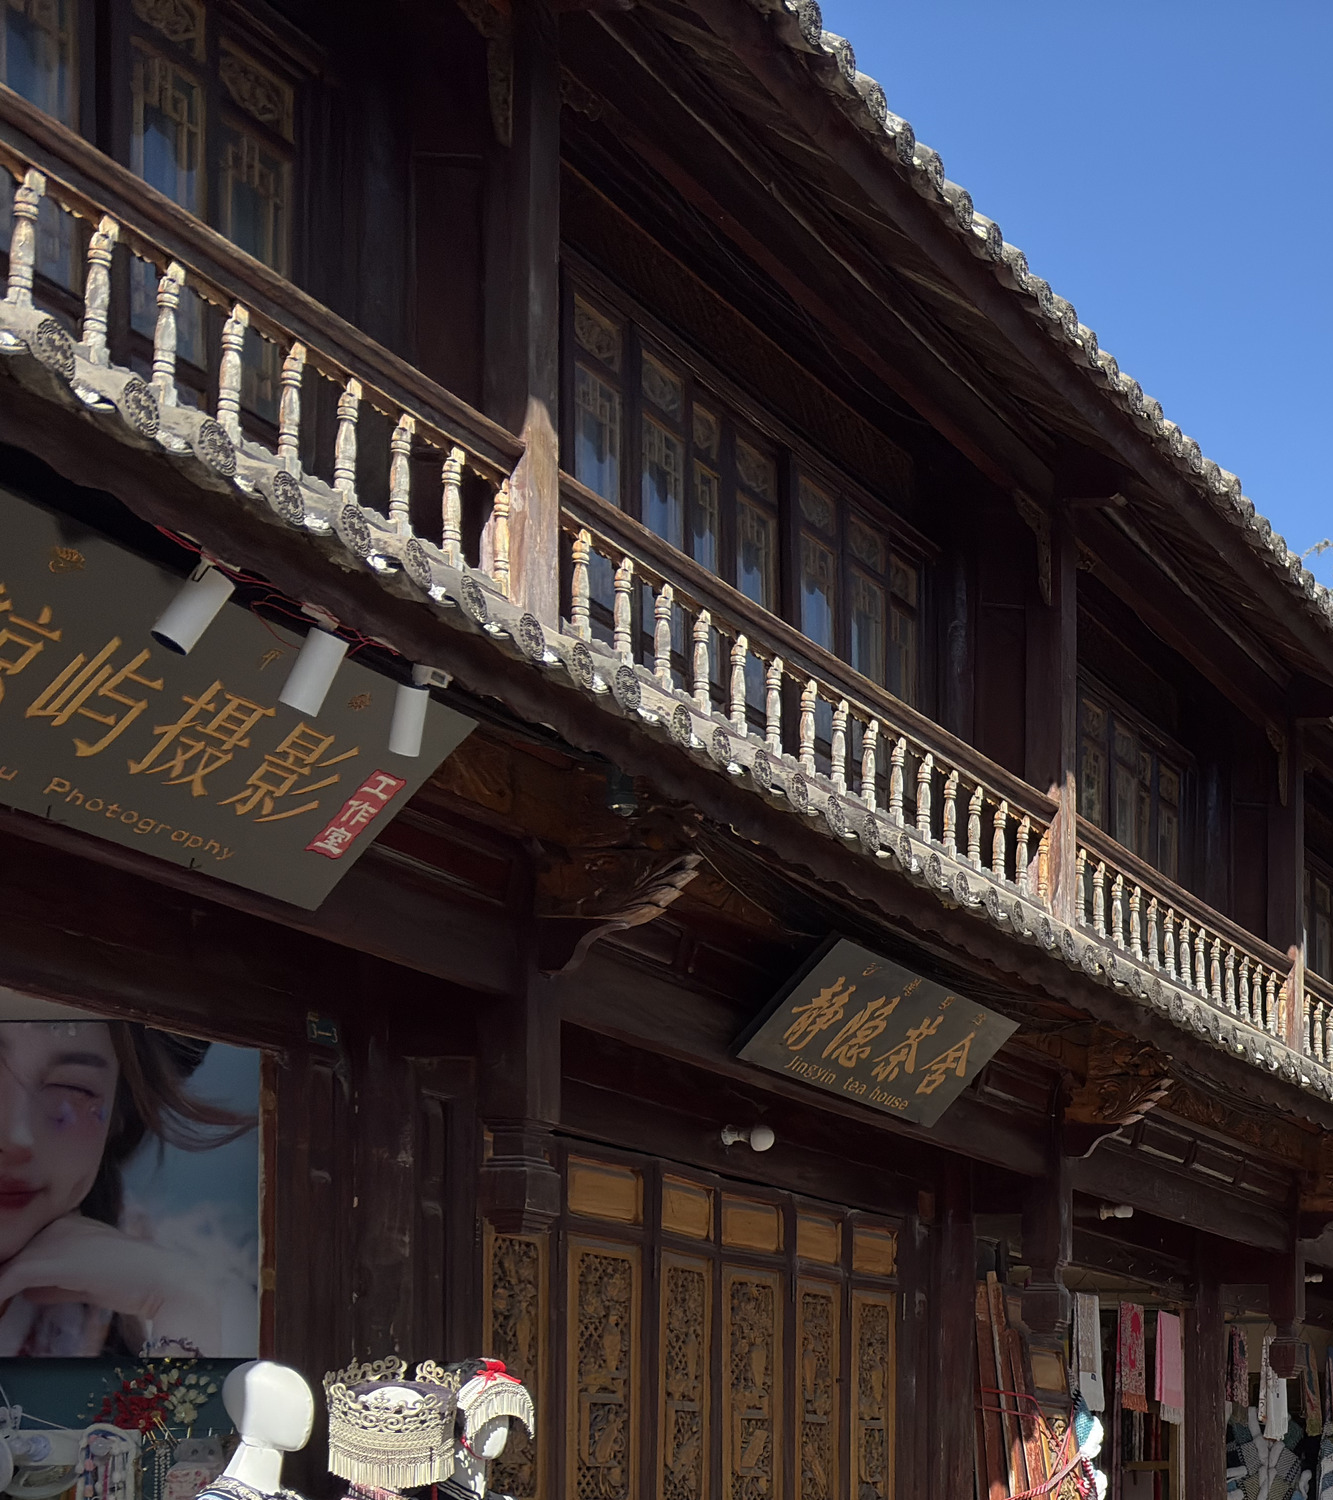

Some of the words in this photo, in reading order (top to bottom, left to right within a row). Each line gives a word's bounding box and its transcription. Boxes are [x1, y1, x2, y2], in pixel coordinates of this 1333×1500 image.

[43, 776, 236, 860] Photography
[315, 774, 402, 854] 工作室
[784, 1055, 836, 1085] Jingyin
[843, 1077, 867, 1096] tea
[868, 1086, 909, 1111] house
